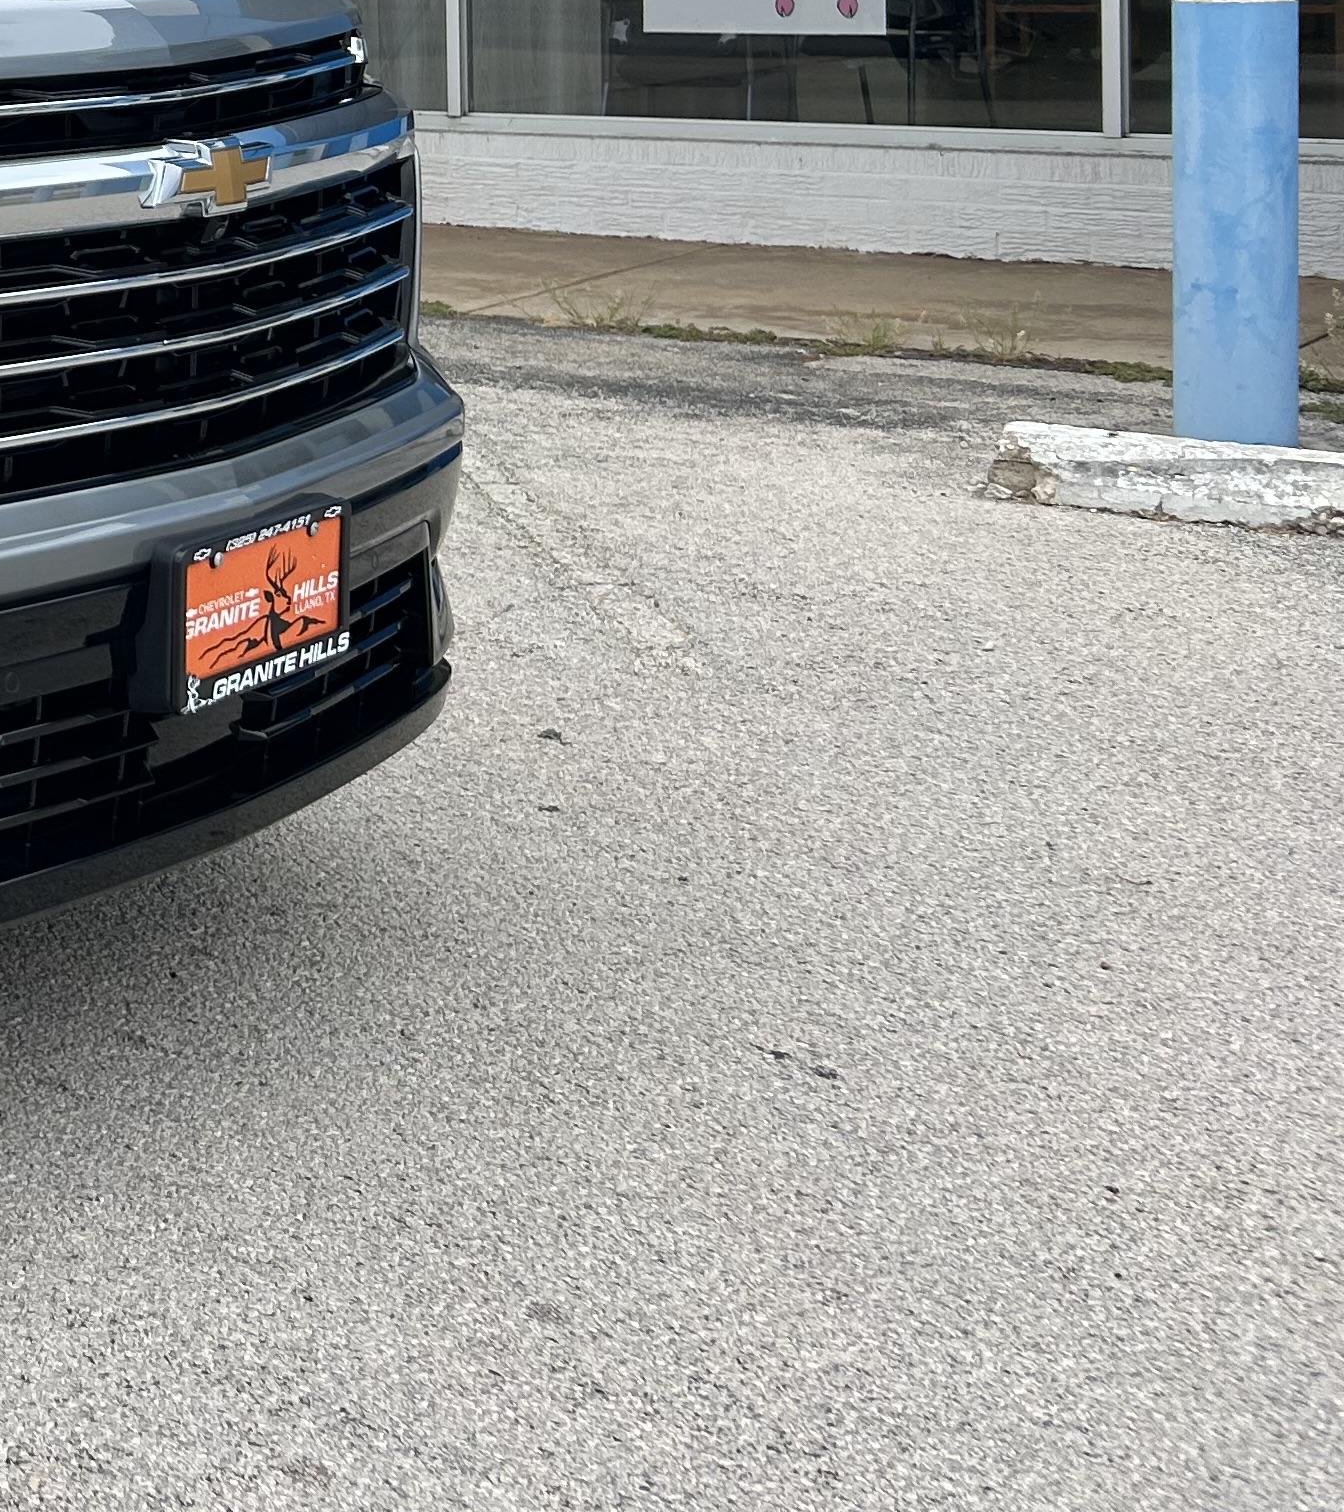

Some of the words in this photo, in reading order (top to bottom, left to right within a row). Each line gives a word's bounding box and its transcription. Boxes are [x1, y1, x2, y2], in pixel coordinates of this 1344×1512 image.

[198, 590, 245, 615] CHEVROLET
[292, 570, 339, 603] HILLS
[325, 590, 337, 604] TX
[186, 597, 262, 640] GRANITE
[212, 650, 296, 700] GRANITE
[298, 631, 351, 669] HILLS
